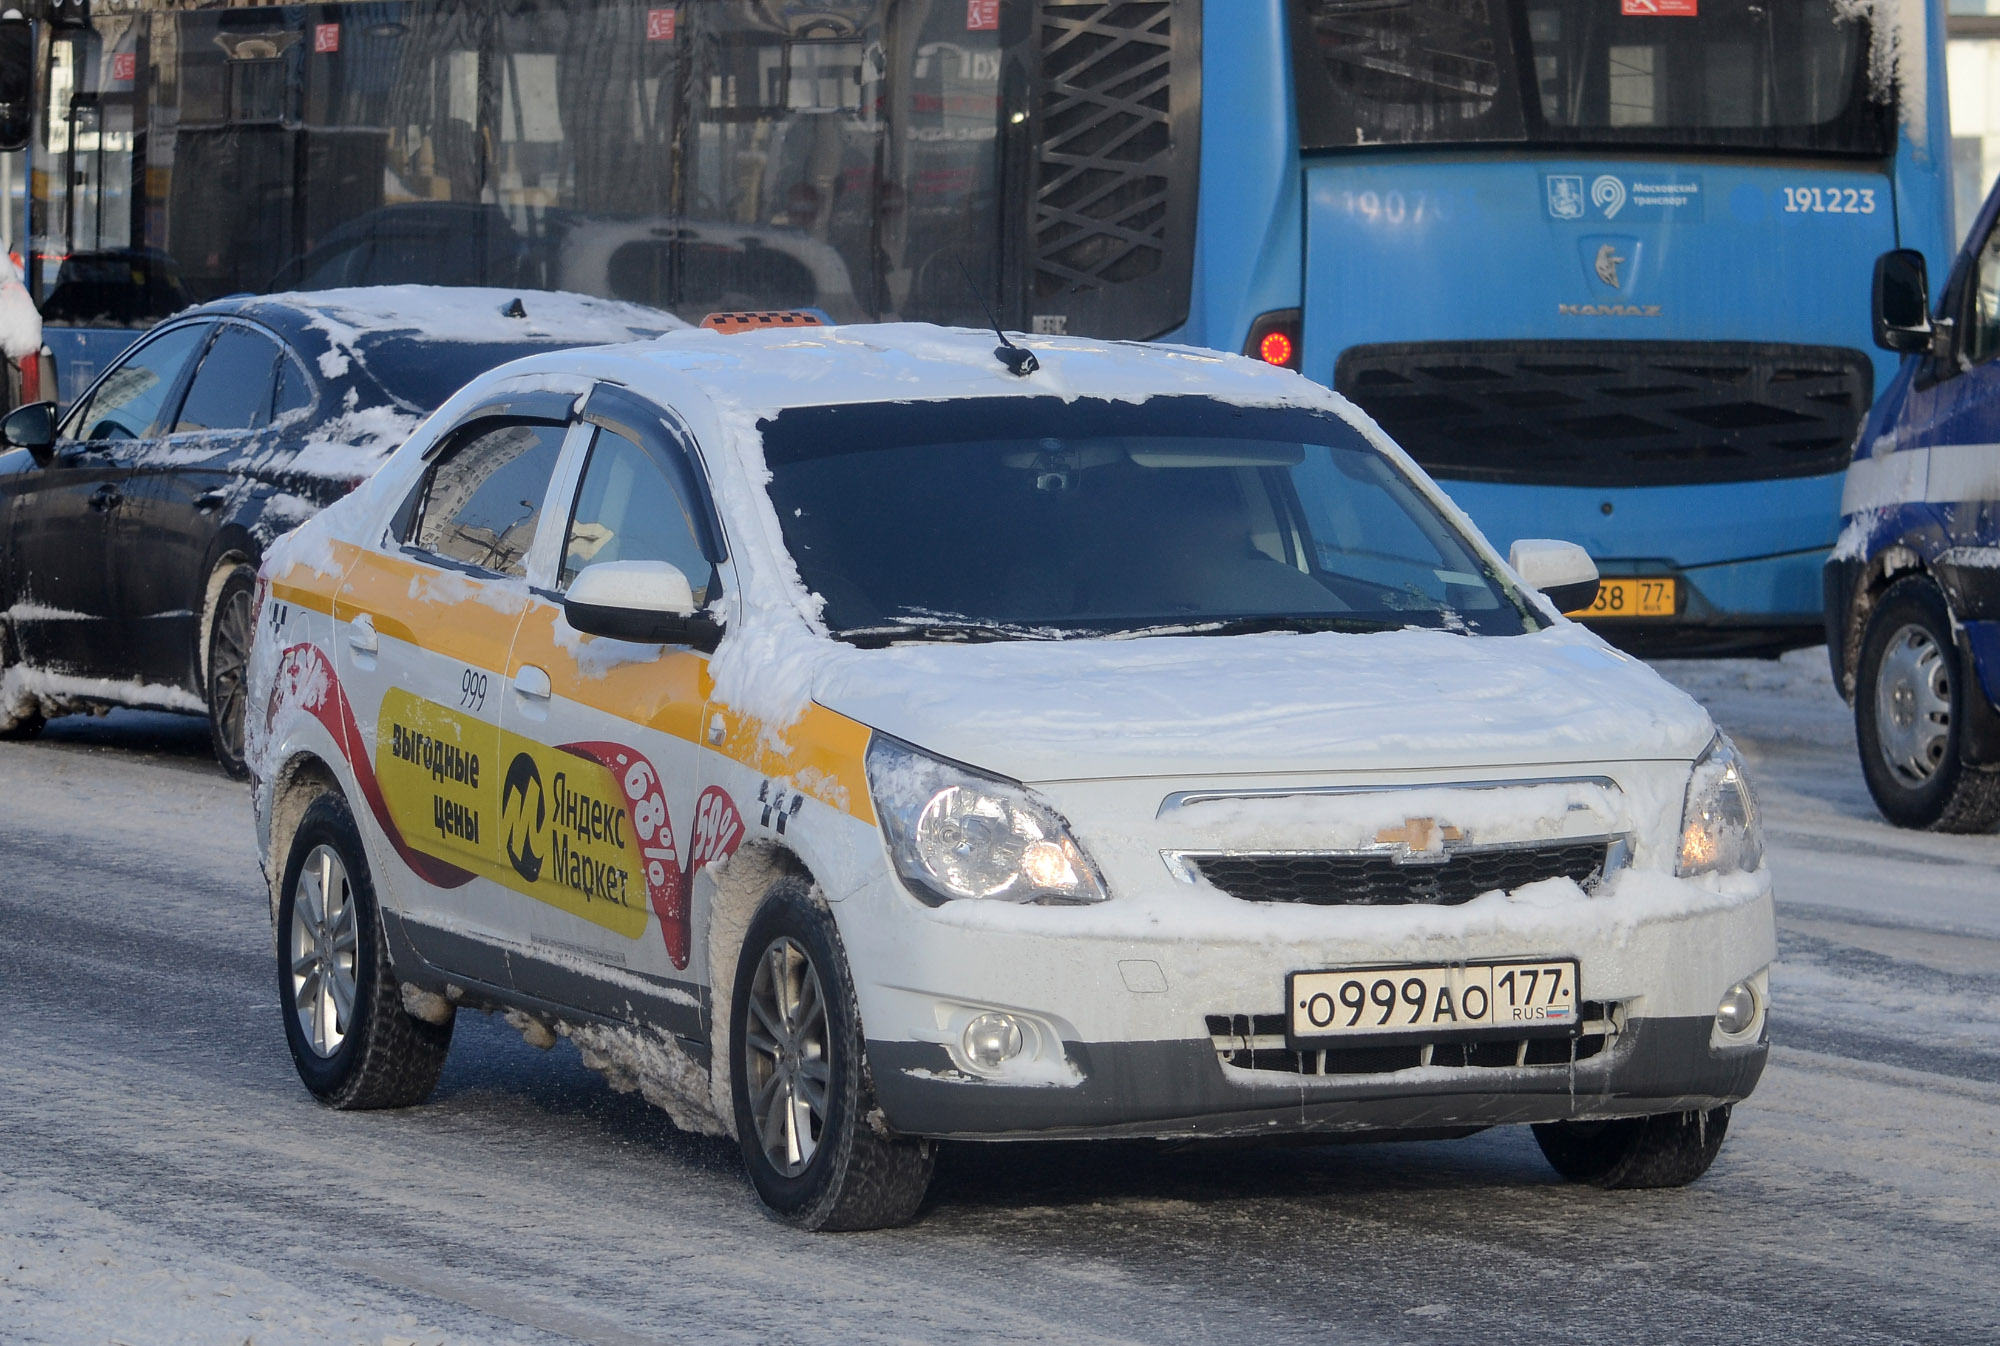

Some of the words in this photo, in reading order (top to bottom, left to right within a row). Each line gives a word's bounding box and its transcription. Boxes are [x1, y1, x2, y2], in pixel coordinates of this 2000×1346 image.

[1632, 182, 1698, 194] Московский
[1632, 196, 1688, 207] транспорт
[1783, 187, 1876, 214] 191223
[1584, 585, 1624, 611] 38
[1641, 583, 1665, 603] 77
[460, 668, 487, 712] 999
[433, 794, 480, 844] цены
[552, 771, 626, 849] Яндекс
[552, 829, 629, 908] Маркет
[1497, 968, 1562, 1006] 177
[1512, 1007, 1545, 1021] RUS
